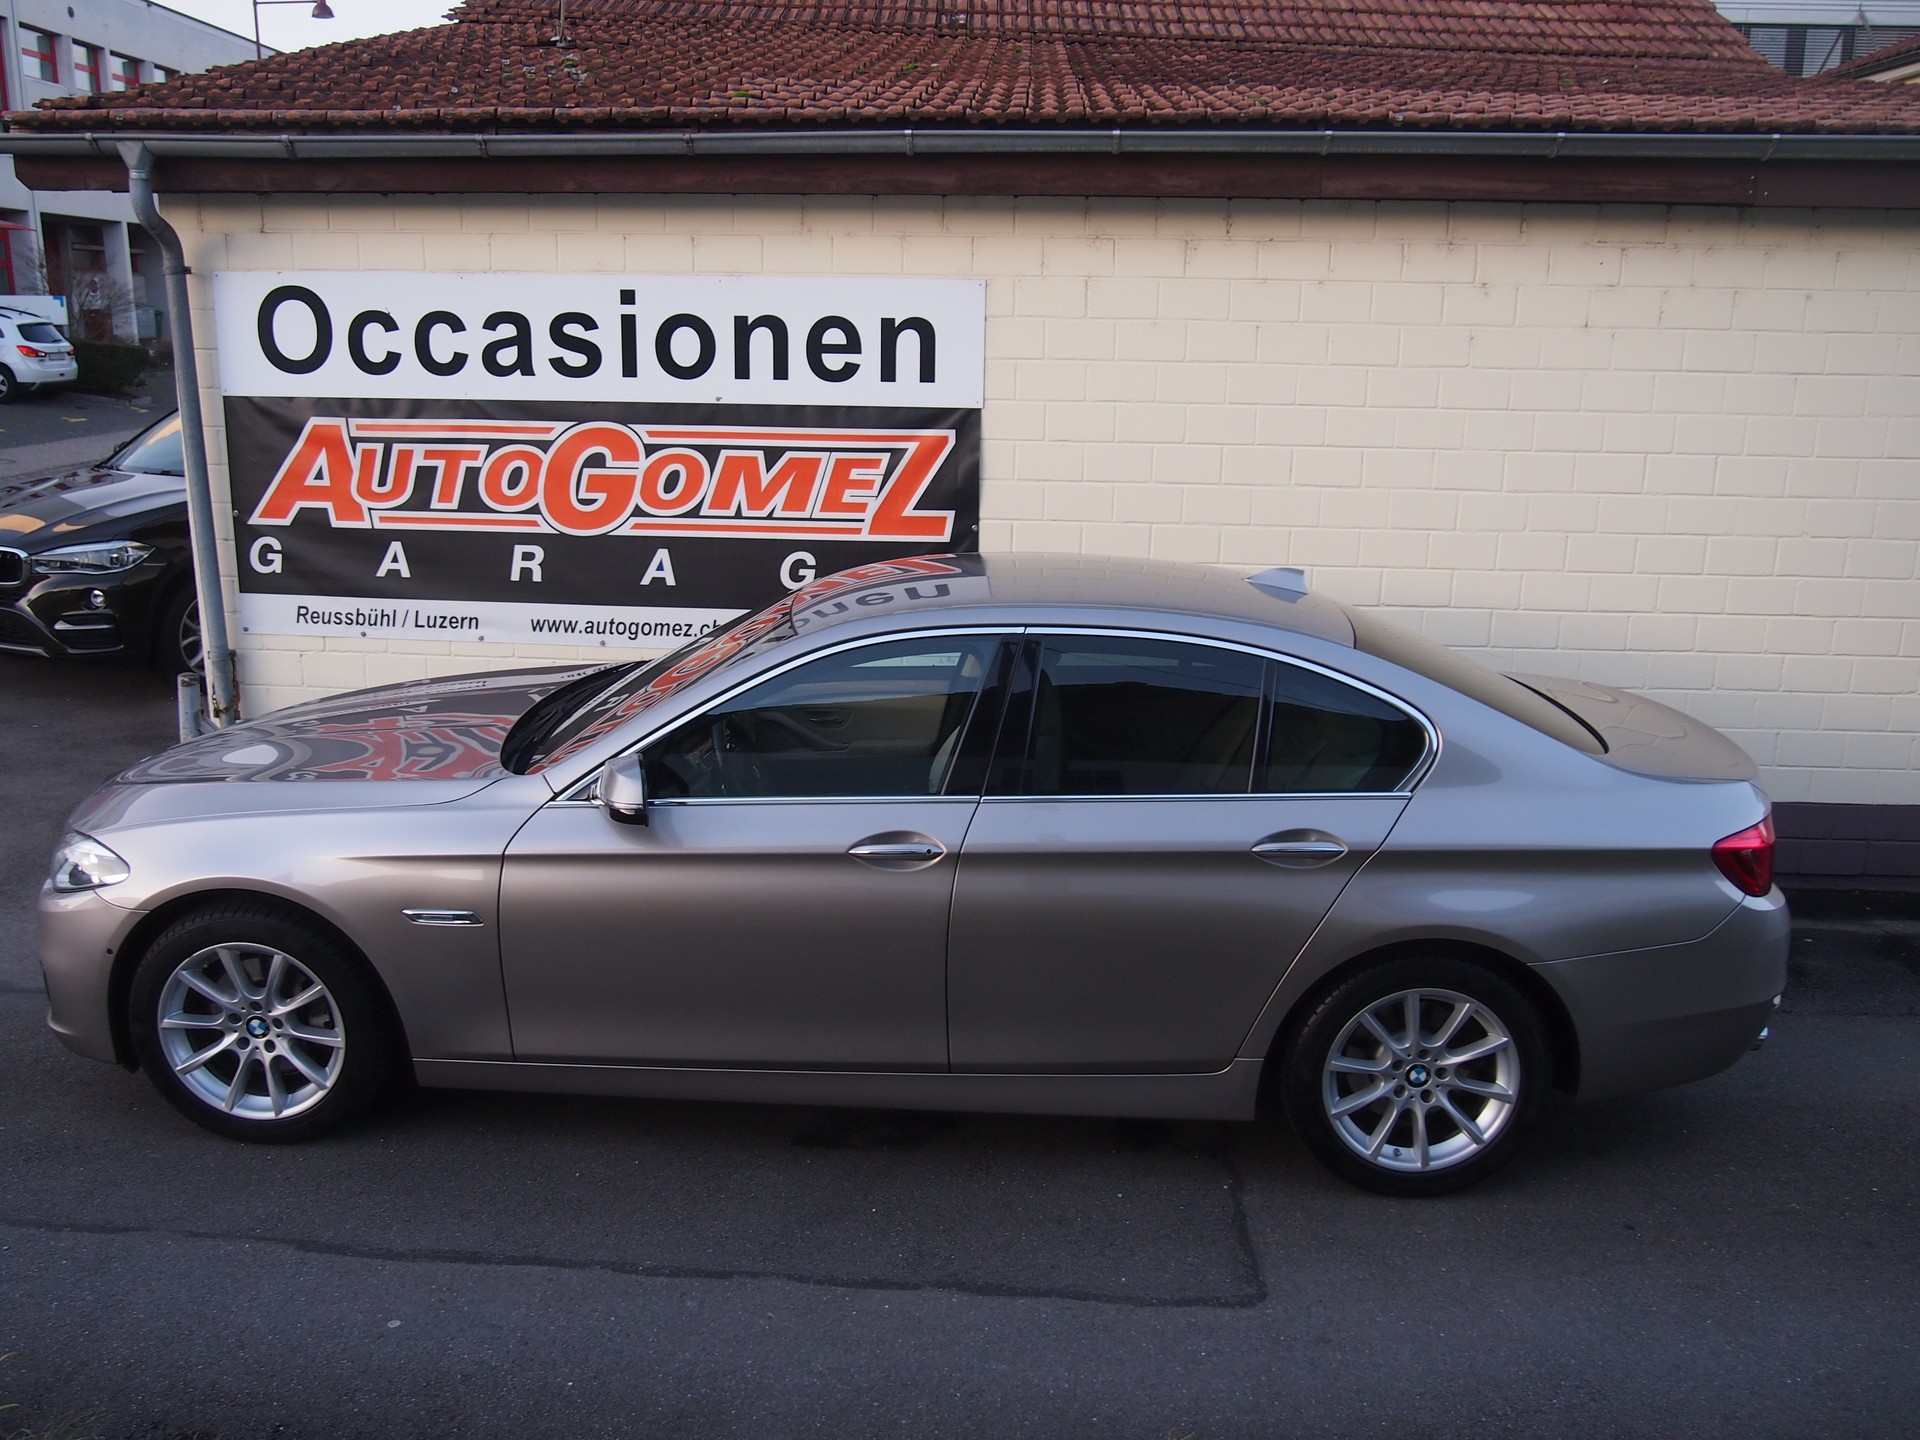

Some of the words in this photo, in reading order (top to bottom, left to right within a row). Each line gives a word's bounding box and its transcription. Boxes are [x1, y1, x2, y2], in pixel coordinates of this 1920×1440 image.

[257, 284, 937, 384] Occasionen
[296, 605, 397, 628] Reussbühl
[414, 610, 480, 630] Luzern
